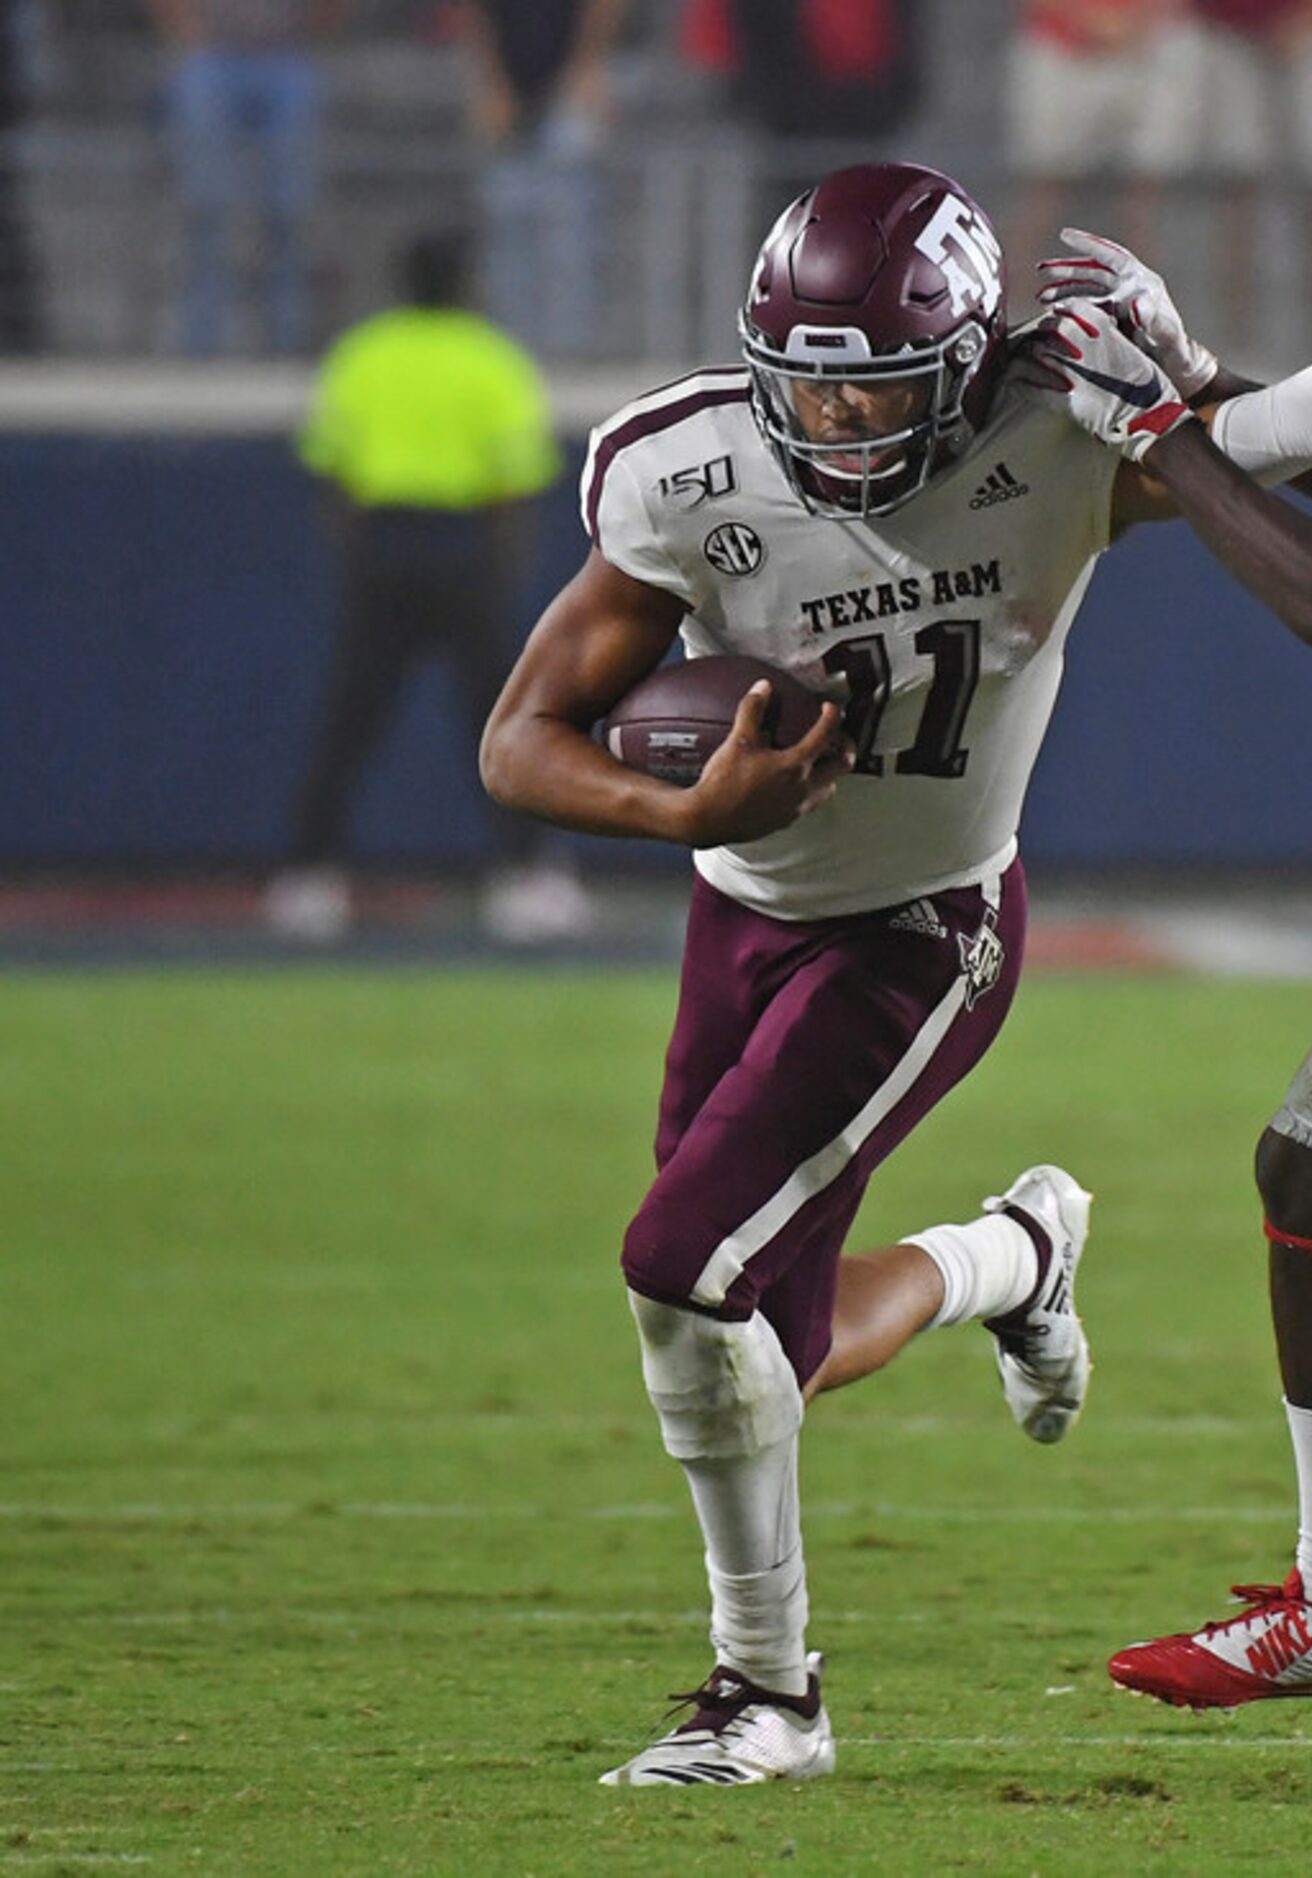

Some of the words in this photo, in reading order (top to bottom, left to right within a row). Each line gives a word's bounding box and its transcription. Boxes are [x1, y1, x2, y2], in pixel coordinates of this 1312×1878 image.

[656, 454, 738, 509] 150
[970, 482, 1029, 512] adidas
[706, 525, 762, 575] SEC
[801, 578, 921, 634] TEXAS
[932, 561, 1003, 607] A&M
[823, 620, 981, 778] 11
[889, 917, 949, 938] adidas
